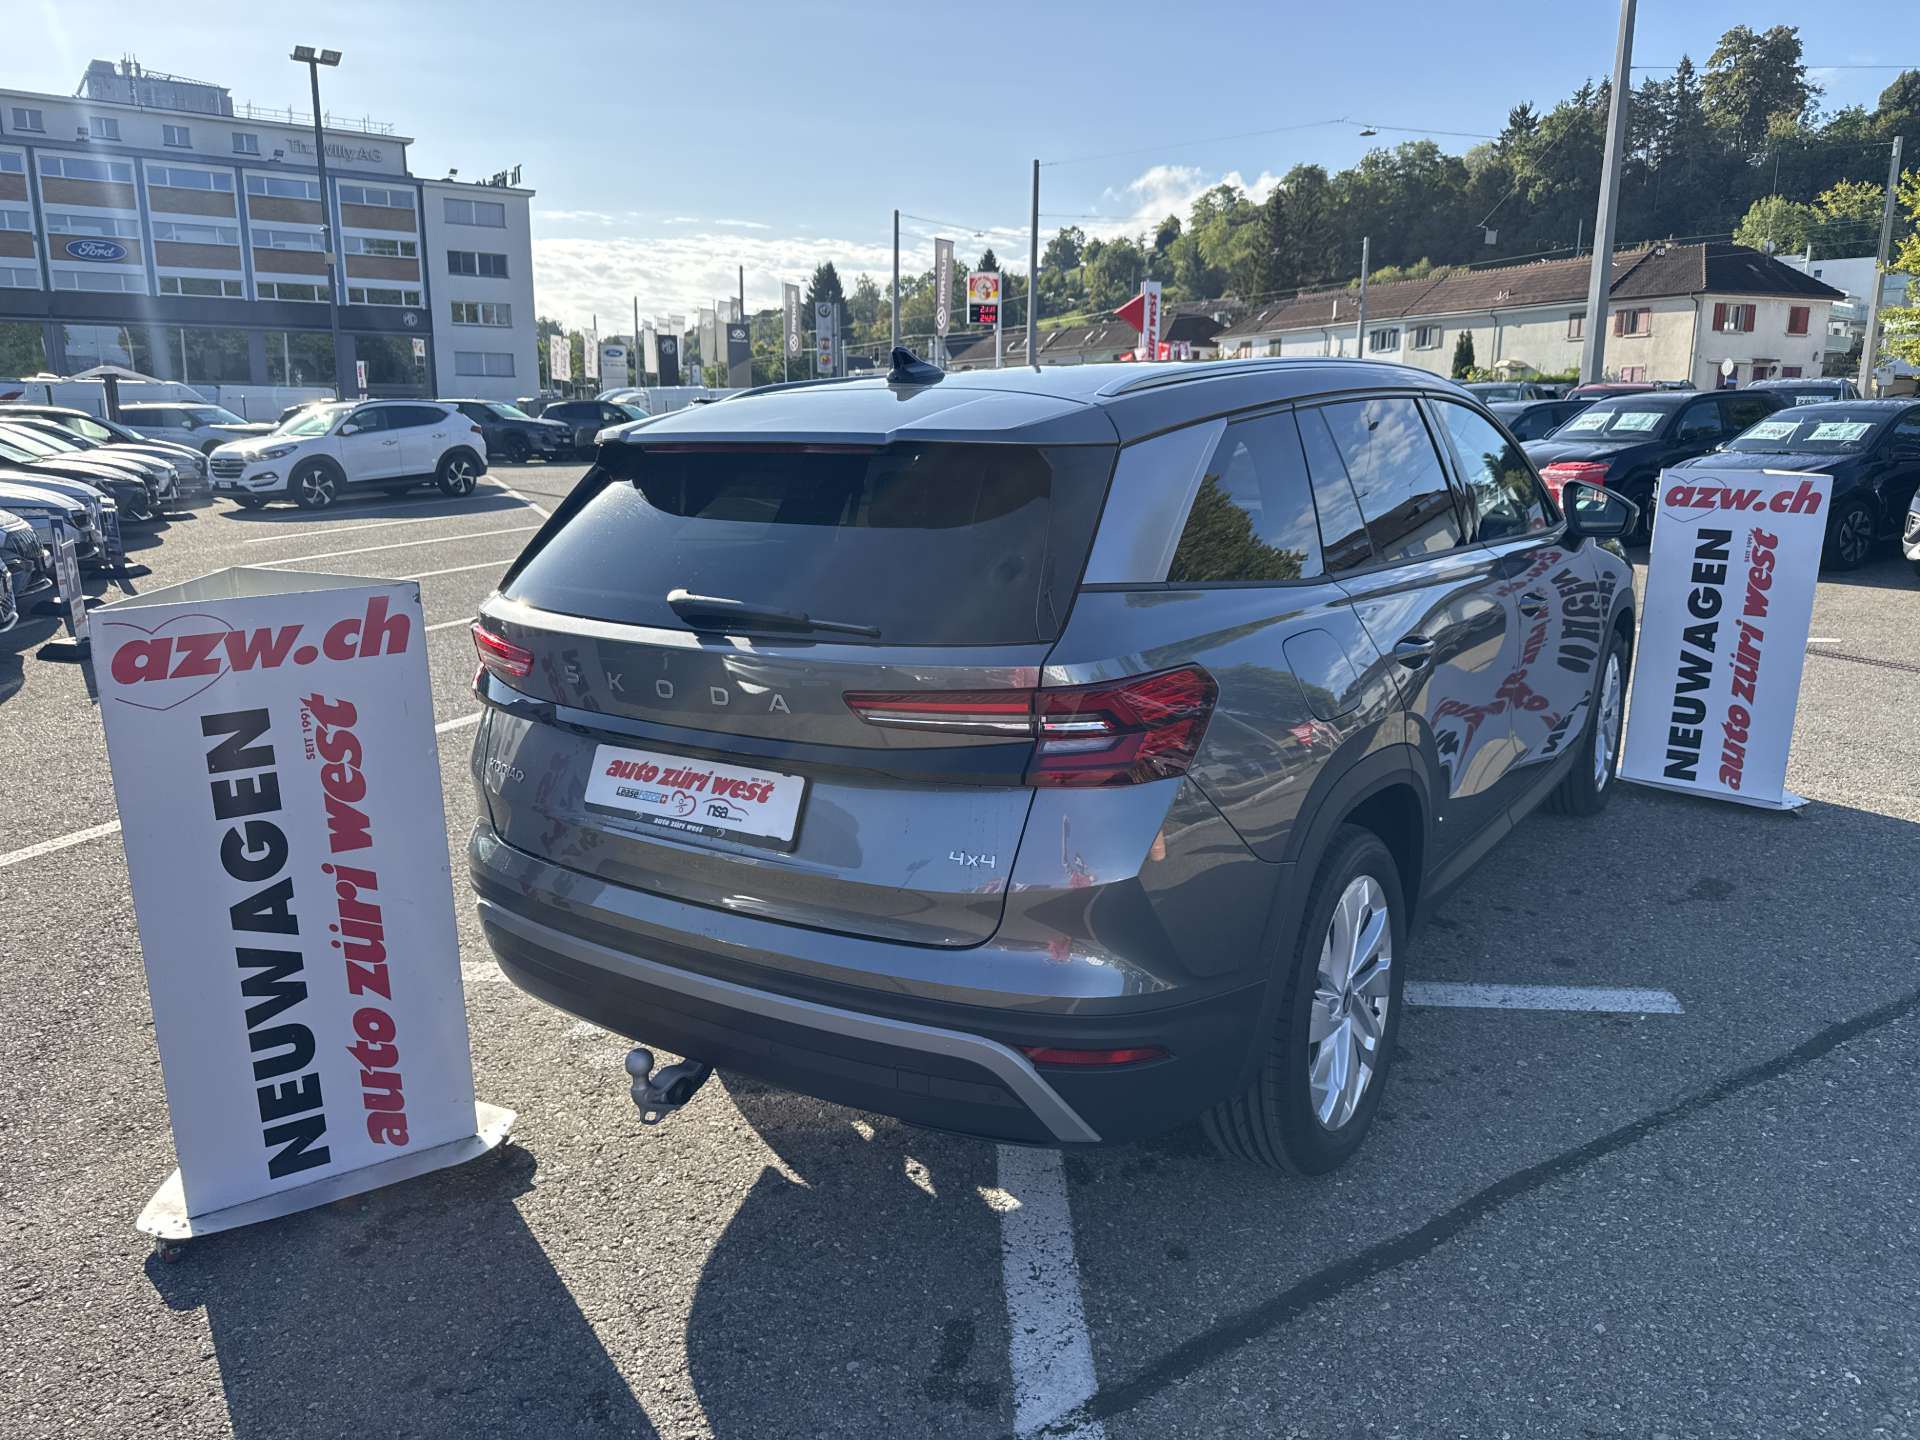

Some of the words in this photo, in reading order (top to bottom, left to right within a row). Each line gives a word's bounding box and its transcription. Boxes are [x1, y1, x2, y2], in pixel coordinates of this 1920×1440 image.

[1665, 480, 1823, 514] azw.ch
[1743, 527, 1779, 618] west
[111, 596, 411, 685] azw.ch
[1663, 528, 1733, 782] NEUWAGEN
[1729, 618, 1764, 706] züri
[300, 708, 312, 734] 1991
[303, 737, 316, 760] SEIT
[1719, 703, 1751, 791] auto
[299, 693, 374, 853] west
[605, 759, 659, 782] auto
[656, 766, 714, 792] züri
[711, 776, 775, 803] west
[706, 804, 729, 819] nsa
[653, 817, 670, 826] auto
[686, 824, 704, 833] west
[948, 851, 996, 869] 4x4
[200, 708, 331, 1180] NEUWAGEN
[321, 863, 392, 1000] züri
[345, 1007, 409, 1147] auto
